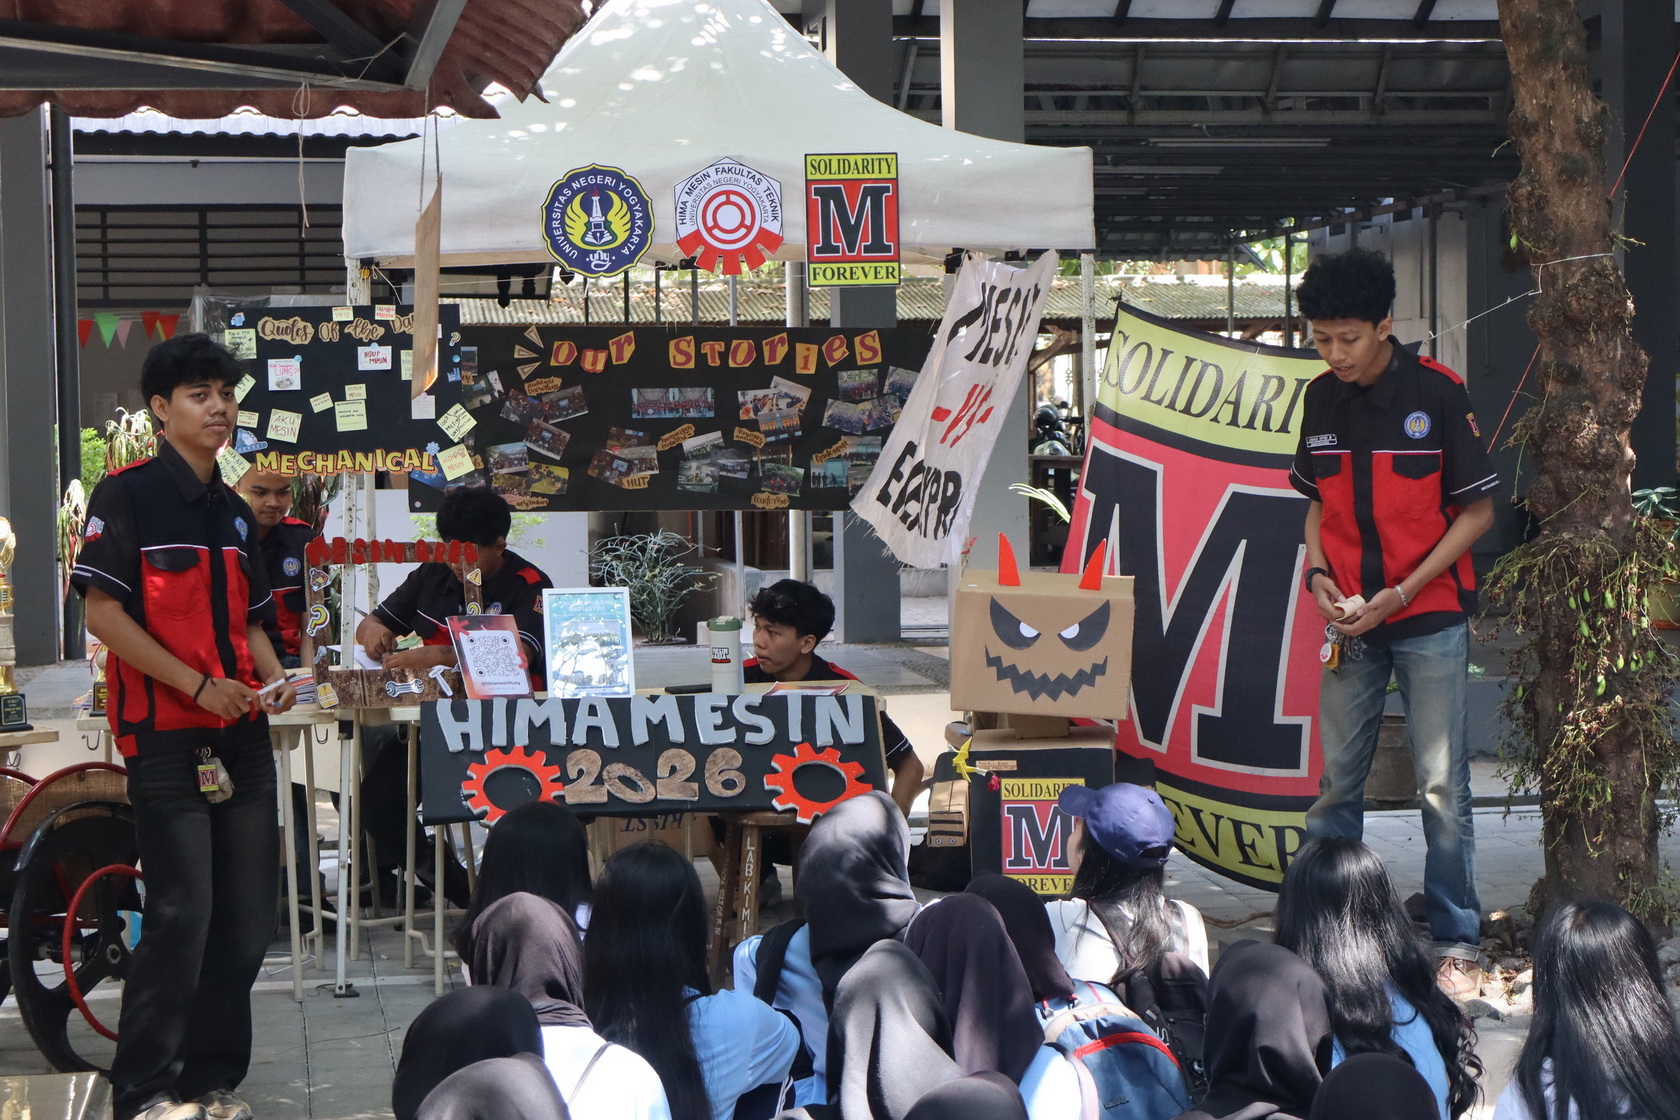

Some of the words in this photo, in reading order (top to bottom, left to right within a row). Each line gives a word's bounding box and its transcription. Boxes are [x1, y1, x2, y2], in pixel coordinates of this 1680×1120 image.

[810, 157, 894, 176] SOLIDARITY
[678, 200, 689, 225] HIMA
[684, 171, 711, 197] MESIN
[715, 166, 763, 186] FAKULTAS
[763, 186, 780, 223] TEKNIK
[689, 181, 713, 226] UNIVERSITAS
[713, 176, 741, 185] NEGERI
[743, 180, 769, 224] YOGYAKARTA
[552, 188, 578, 259] UNIVERSITAS
[571, 175, 616, 190] NEGERI
[618, 182, 643, 255] YOGYAKARTA
[812, 184, 894, 256] M
[812, 265, 897, 281] FOREVER
[260, 319, 312, 342] Quotes
[1103, 330, 1311, 434] SOLIDARI
[269, 424, 297, 438] MESIN
[256, 448, 437, 476] MECHANICAL
[626, 476, 649, 487] HUT
[306, 535, 405, 566] MESIN
[563, 746, 747, 805] 2026
[1004, 782, 1084, 799] SOLIDAR
[1005, 804, 1075, 870] M
